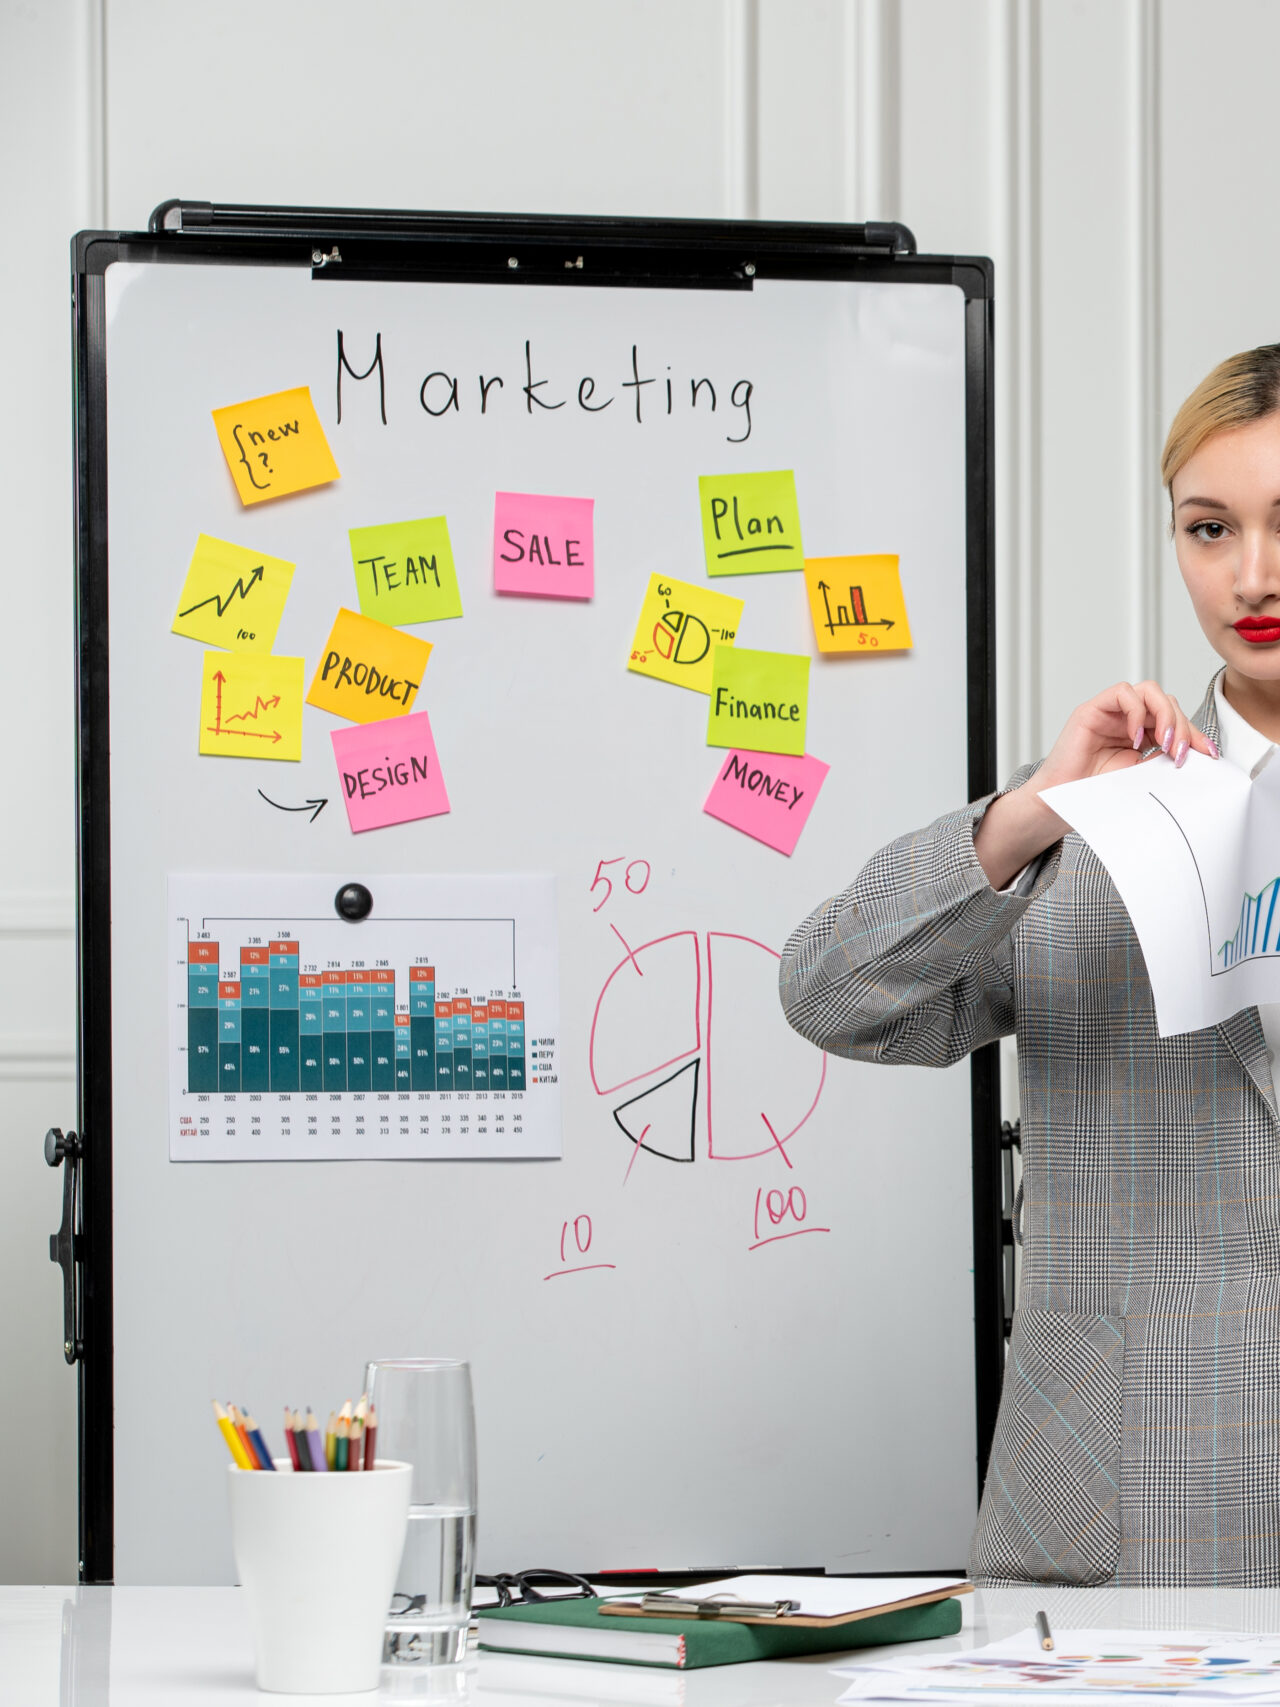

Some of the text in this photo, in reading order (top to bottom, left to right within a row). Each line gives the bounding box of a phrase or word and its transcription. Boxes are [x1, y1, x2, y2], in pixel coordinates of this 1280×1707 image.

[336, 329, 754, 442] Marketing
[248, 419, 300, 446] new
[257, 452, 274, 474] ?
[711, 496, 785, 540] Plan
[500, 529, 585, 567] SALE
[358, 554, 440, 596] TEAM
[236, 629, 256, 641] 100
[857, 633, 879, 647] 50
[321, 651, 419, 705] PRODUCT
[714, 687, 800, 722] Finance
[344, 756, 428, 799] DESIGN
[722, 754, 804, 810] MONEY
[590, 856, 651, 912] 50
[538, 1039, 555, 1047] ЧИЛИ
[538, 1051, 554, 1059] ПЕРУ
[538, 1063, 553, 1071] США
[539, 1074, 558, 1084] КИТАЙ
[180, 1117, 193, 1125] США
[180, 1129, 198, 1137] КИТАЙ
[755, 1186, 807, 1239] 100
[560, 1214, 592, 1262] 10
